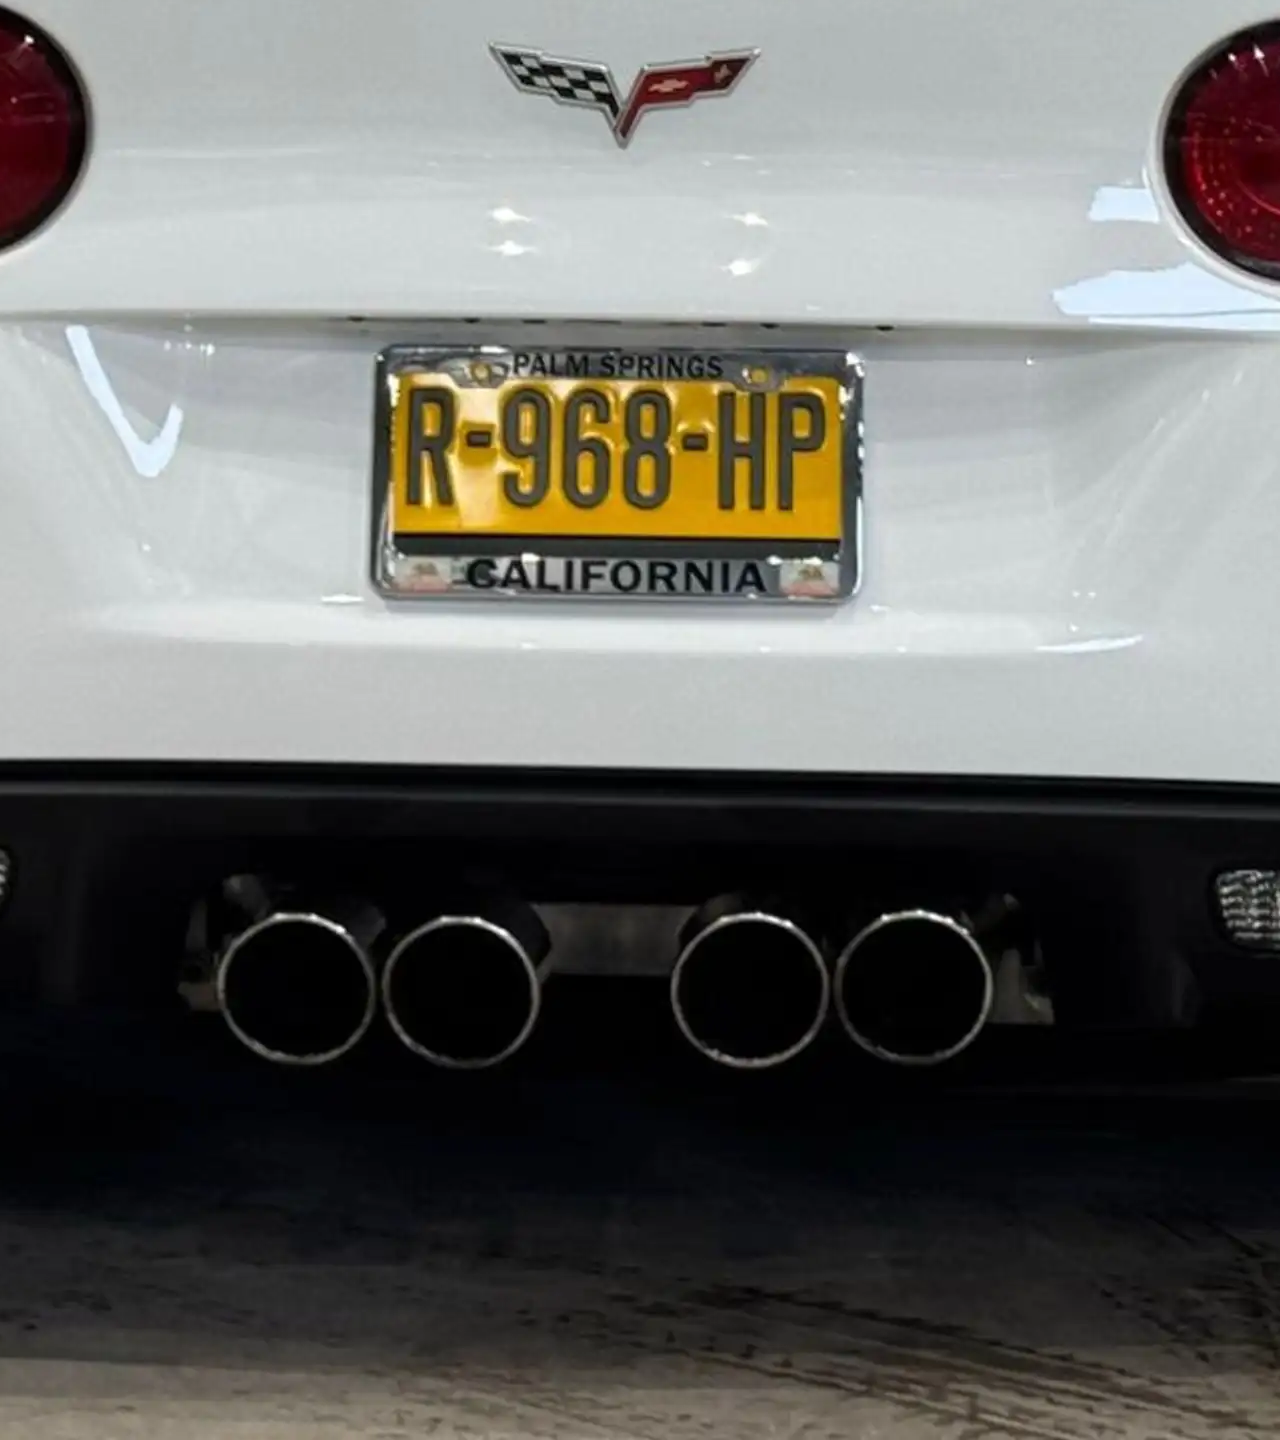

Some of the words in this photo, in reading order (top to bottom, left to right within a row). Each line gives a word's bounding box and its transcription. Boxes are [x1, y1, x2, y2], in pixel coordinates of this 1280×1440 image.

[512, 352, 592, 378] PALM
[598, 354, 722, 380] SPRINGS
[405, 389, 826, 510] R-968-HP
[466, 558, 767, 594] CALIFORNIA
